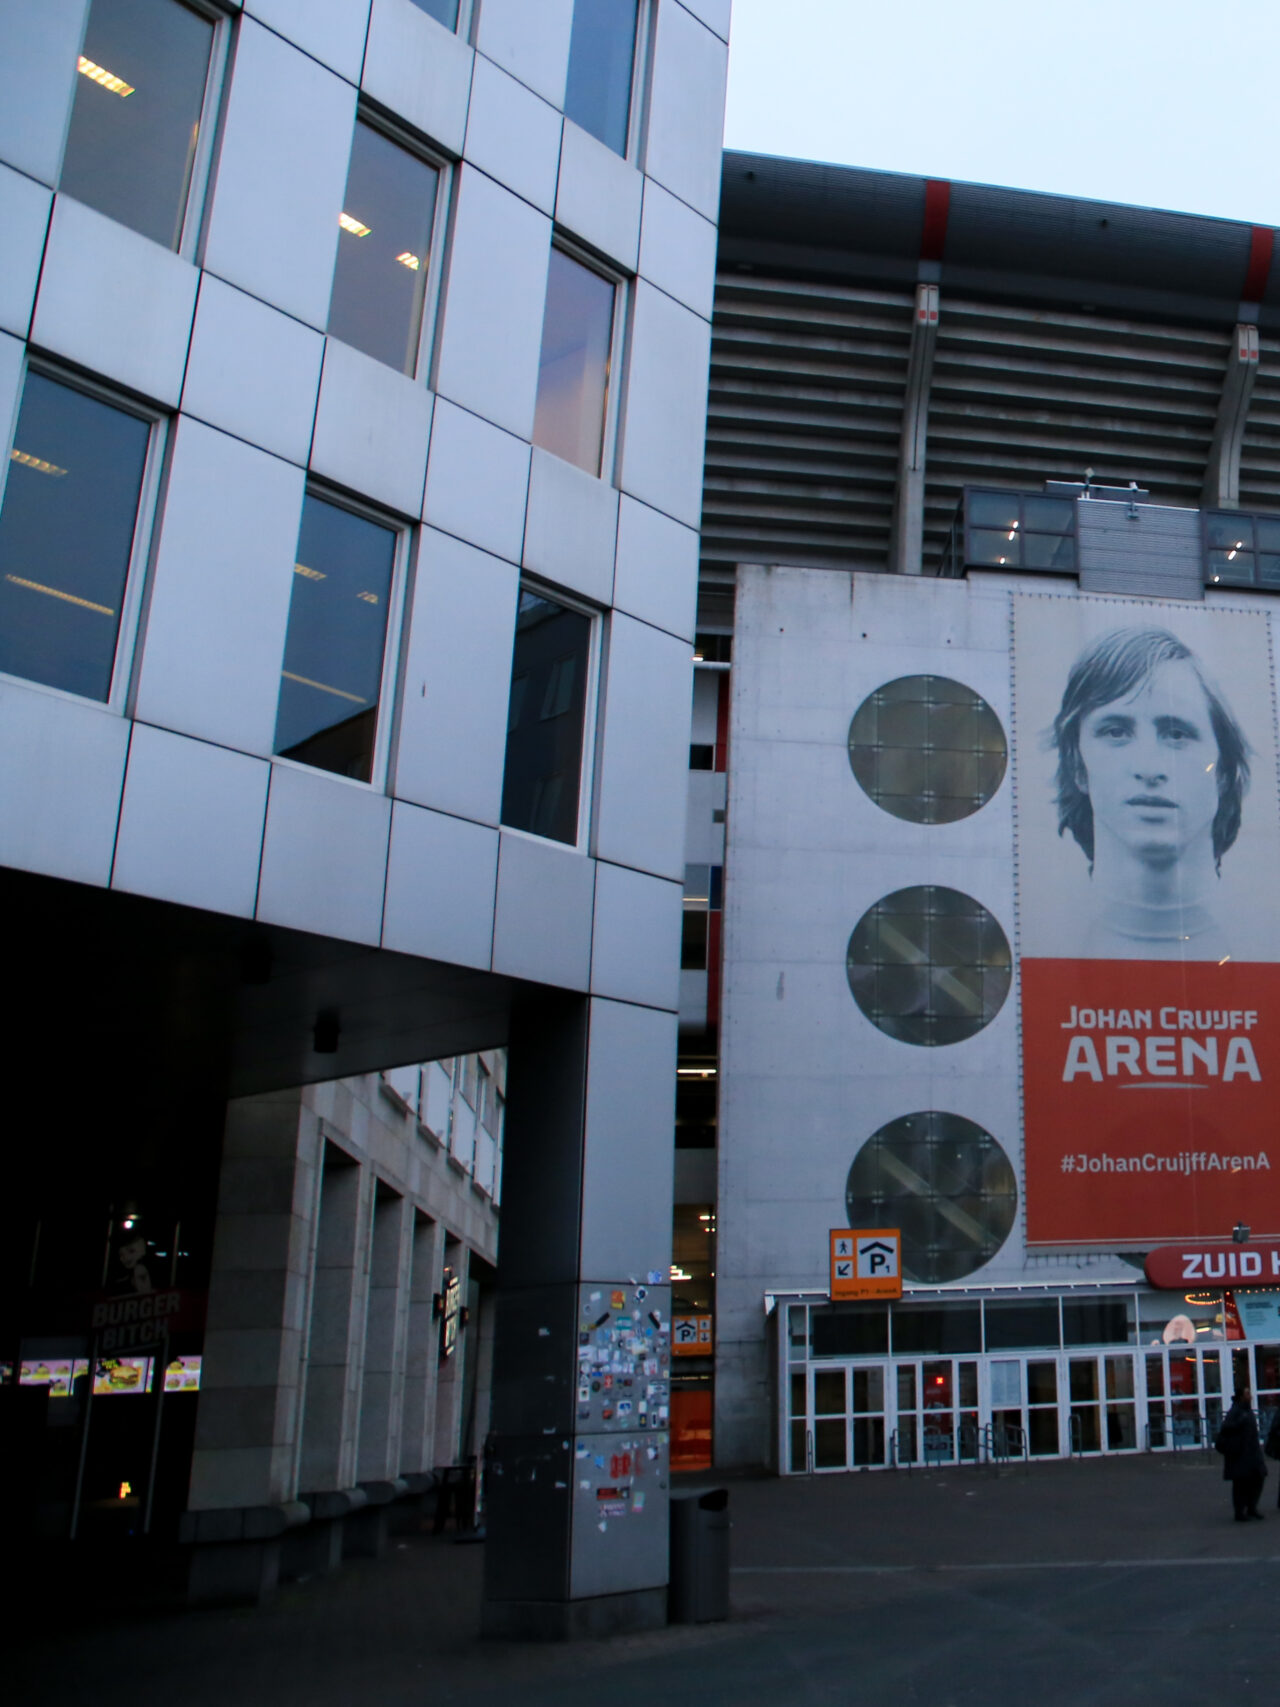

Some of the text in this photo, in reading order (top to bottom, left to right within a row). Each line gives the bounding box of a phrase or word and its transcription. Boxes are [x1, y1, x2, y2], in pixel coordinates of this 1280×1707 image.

[1061, 1005, 1152, 1029] JOHAN
[1062, 1035, 1262, 1082] ARENA
[1060, 1151, 1270, 1176] #JohanCruijffArenA
[1182, 1252, 1262, 1279] ZUID
[92, 1291, 181, 1328] BURGER
[102, 1319, 169, 1351] BITCH
